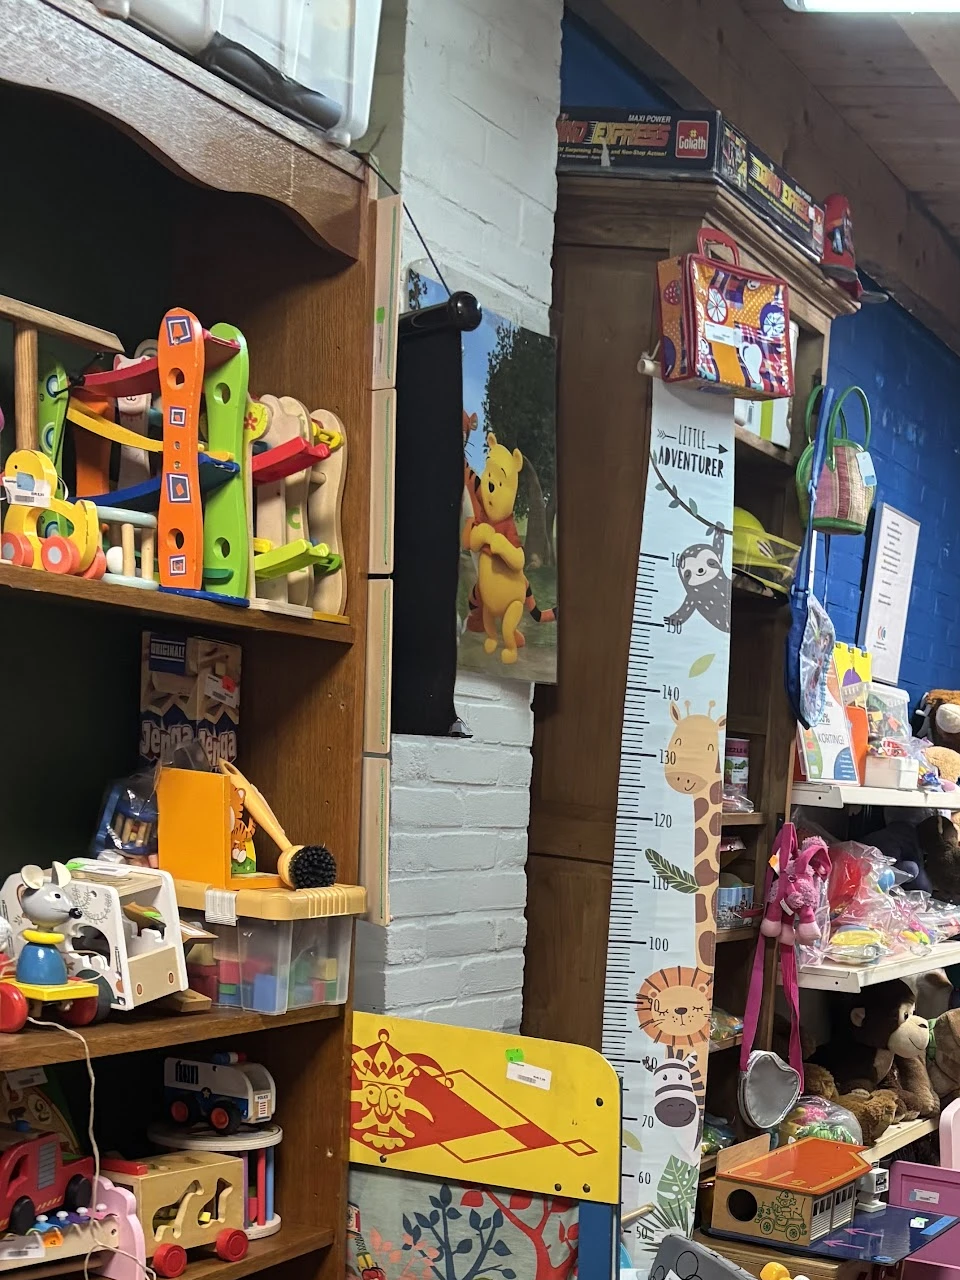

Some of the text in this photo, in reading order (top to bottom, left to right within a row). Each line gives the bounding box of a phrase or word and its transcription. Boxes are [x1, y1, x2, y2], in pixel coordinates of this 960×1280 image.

[628, 114, 672, 123] MAXI POWER
[592, 121, 671, 147] EXPRESS
[679, 135, 706, 150] Goliath
[678, 424, 706, 450] LITTLE
[658, 445, 724, 479] ADVENTURER
[671, 551, 686, 569] 160
[666, 619, 682, 635] 150
[662, 684, 680, 702] 140
[659, 748, 677, 766] 130
[654, 812, 673, 829] 120
[652, 875, 669, 891] 110
[649, 936, 669, 952] 100
[648, 997, 660, 1013] 90
[641, 1114, 654, 1129] 70
[638, 1172, 651, 1185] 60
[636, 1226, 648, 1240] 50
